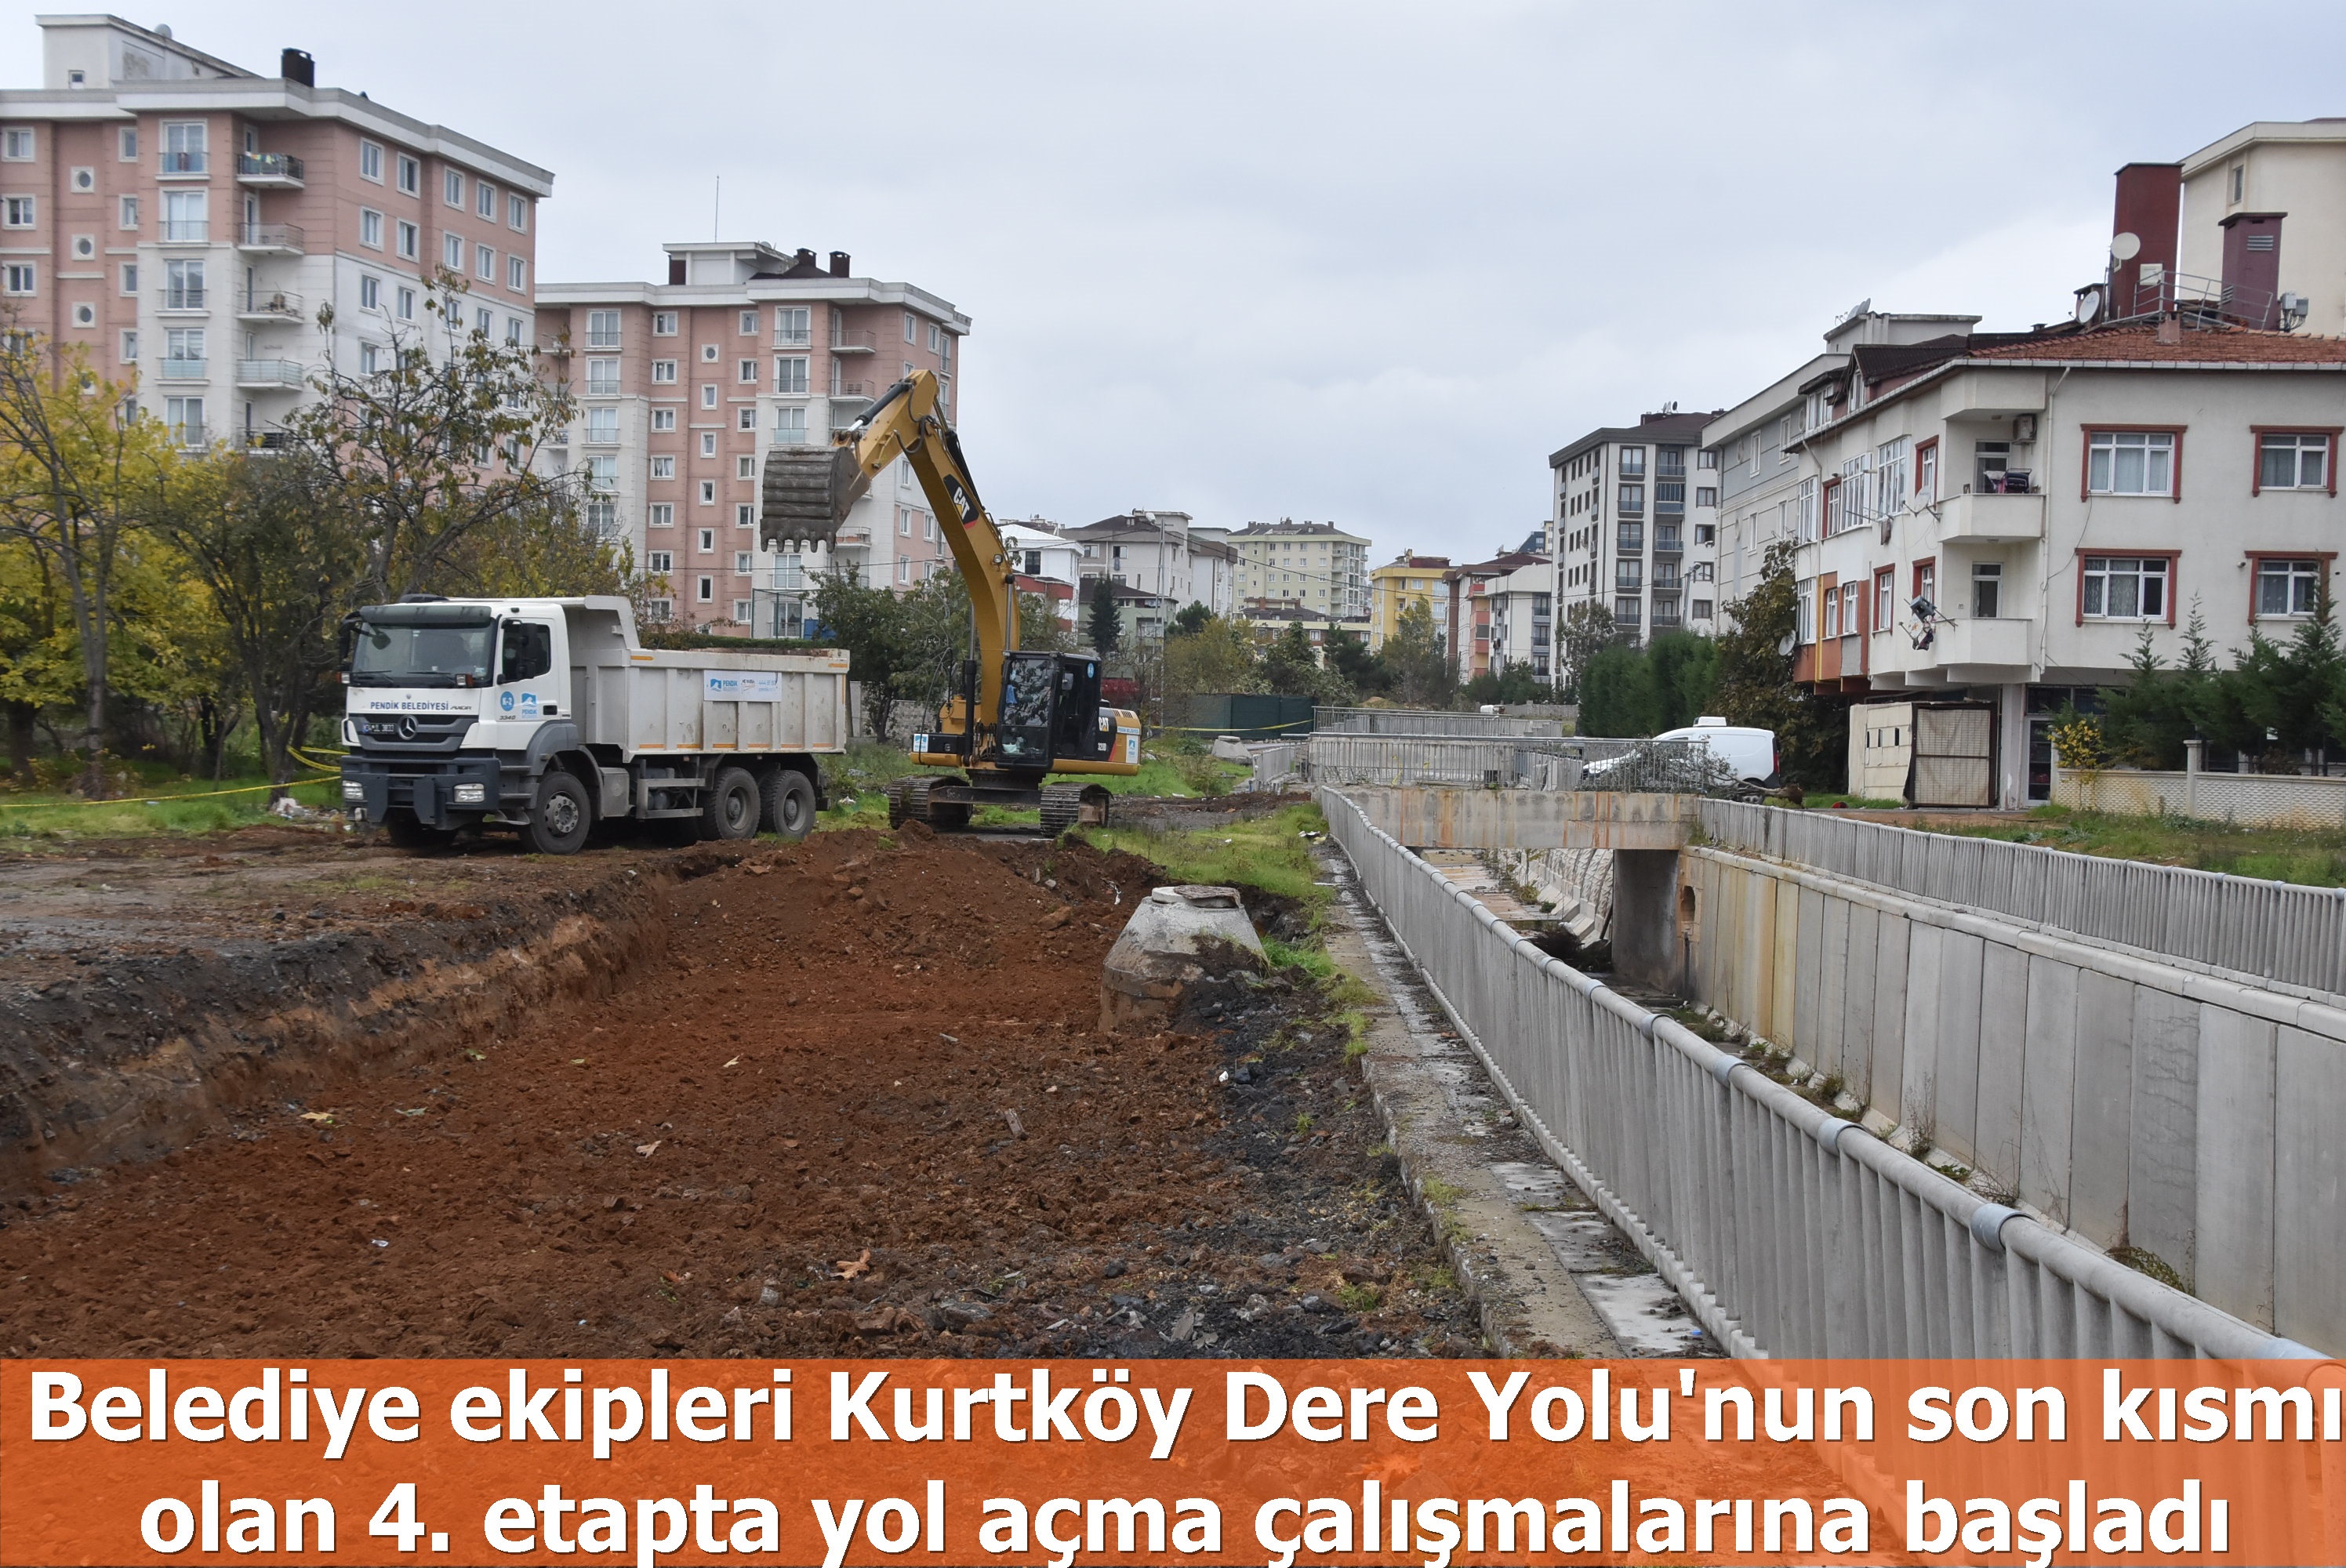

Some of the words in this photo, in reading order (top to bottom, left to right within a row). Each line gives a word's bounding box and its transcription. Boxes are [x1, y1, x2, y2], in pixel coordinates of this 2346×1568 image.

[953, 487, 970, 520] CAT
[370, 700, 399, 710] PENDİK
[401, 700, 448, 710] BELEDİYESİ
[1099, 717, 1109, 731] CAT
